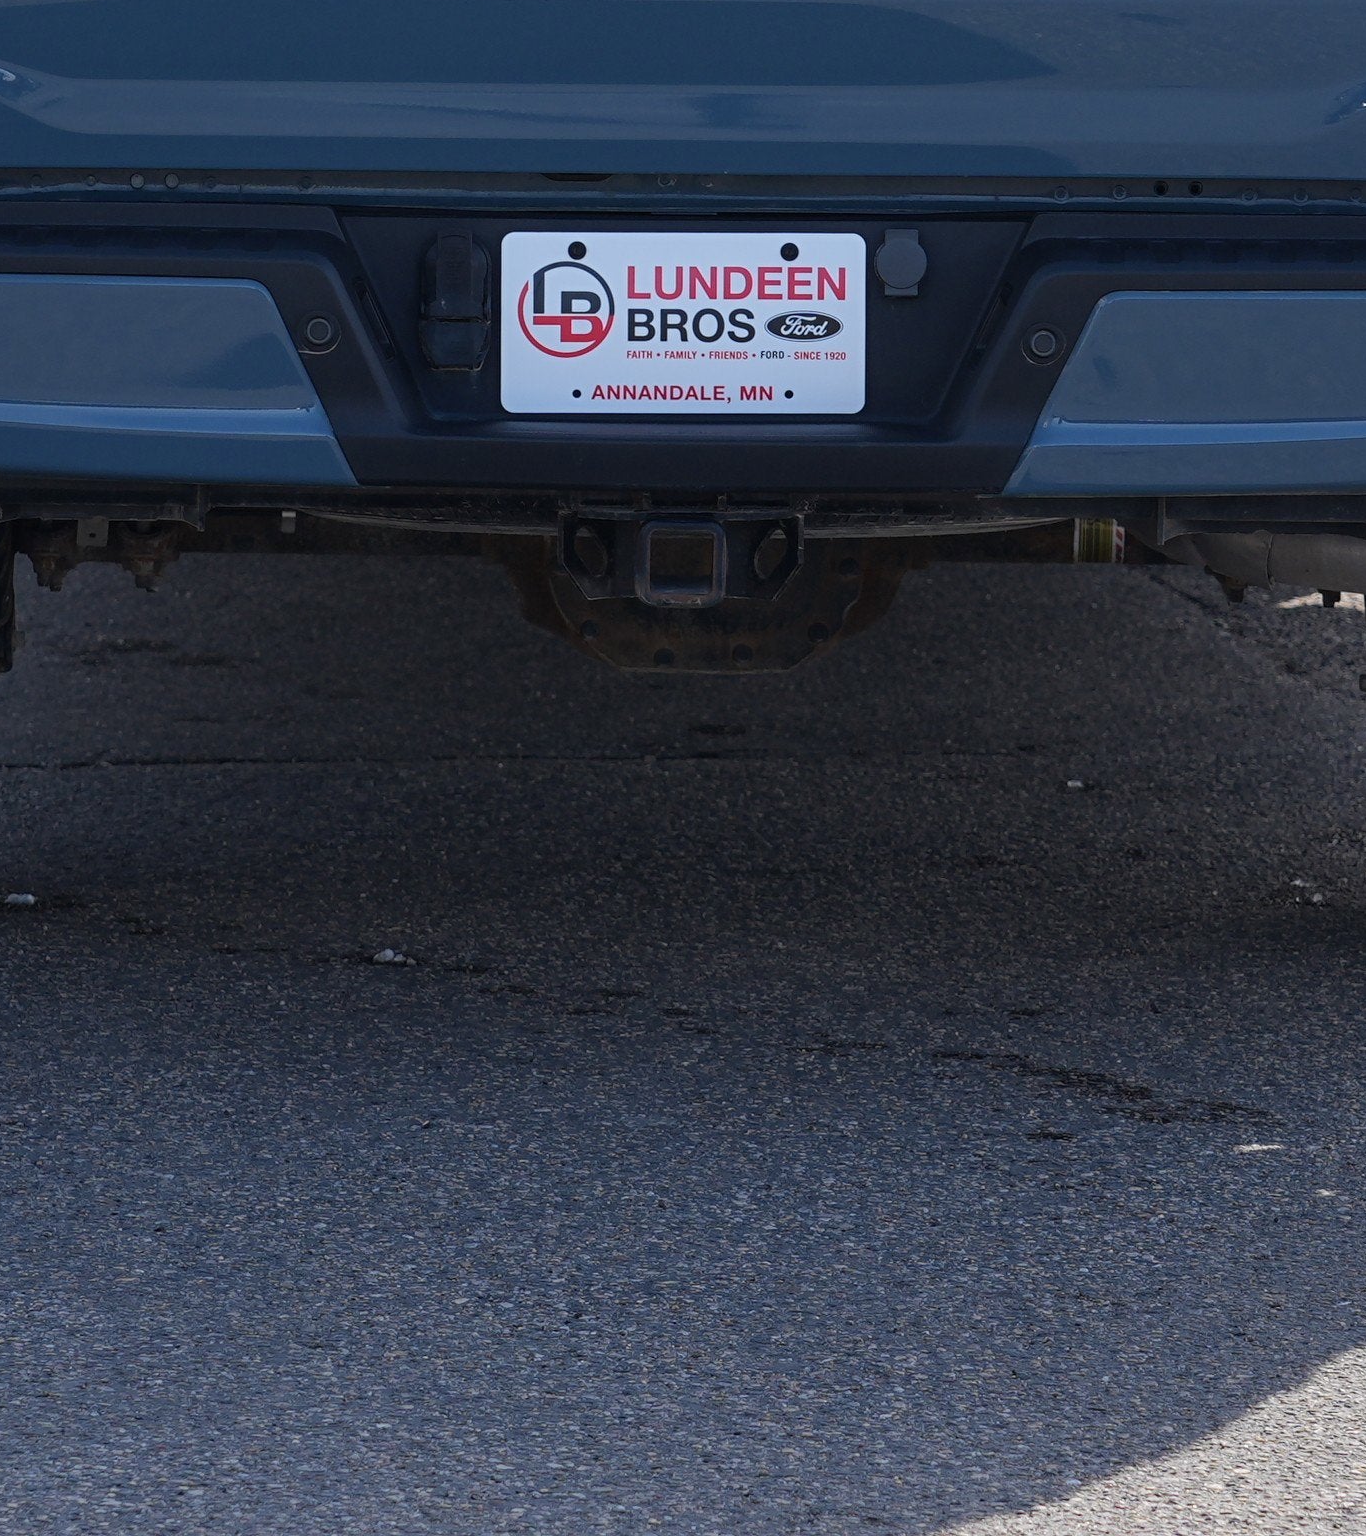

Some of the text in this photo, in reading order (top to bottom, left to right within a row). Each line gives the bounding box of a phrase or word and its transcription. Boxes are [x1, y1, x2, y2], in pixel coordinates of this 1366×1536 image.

[627, 266, 846, 300] LUNDEEN
[627, 308, 829, 342] BROS Ford
[626, 350, 846, 361] FAITH FAMILY FRIENDS FORD SINCE 1920
[591, 385, 773, 403] ANNANDALE, MN
